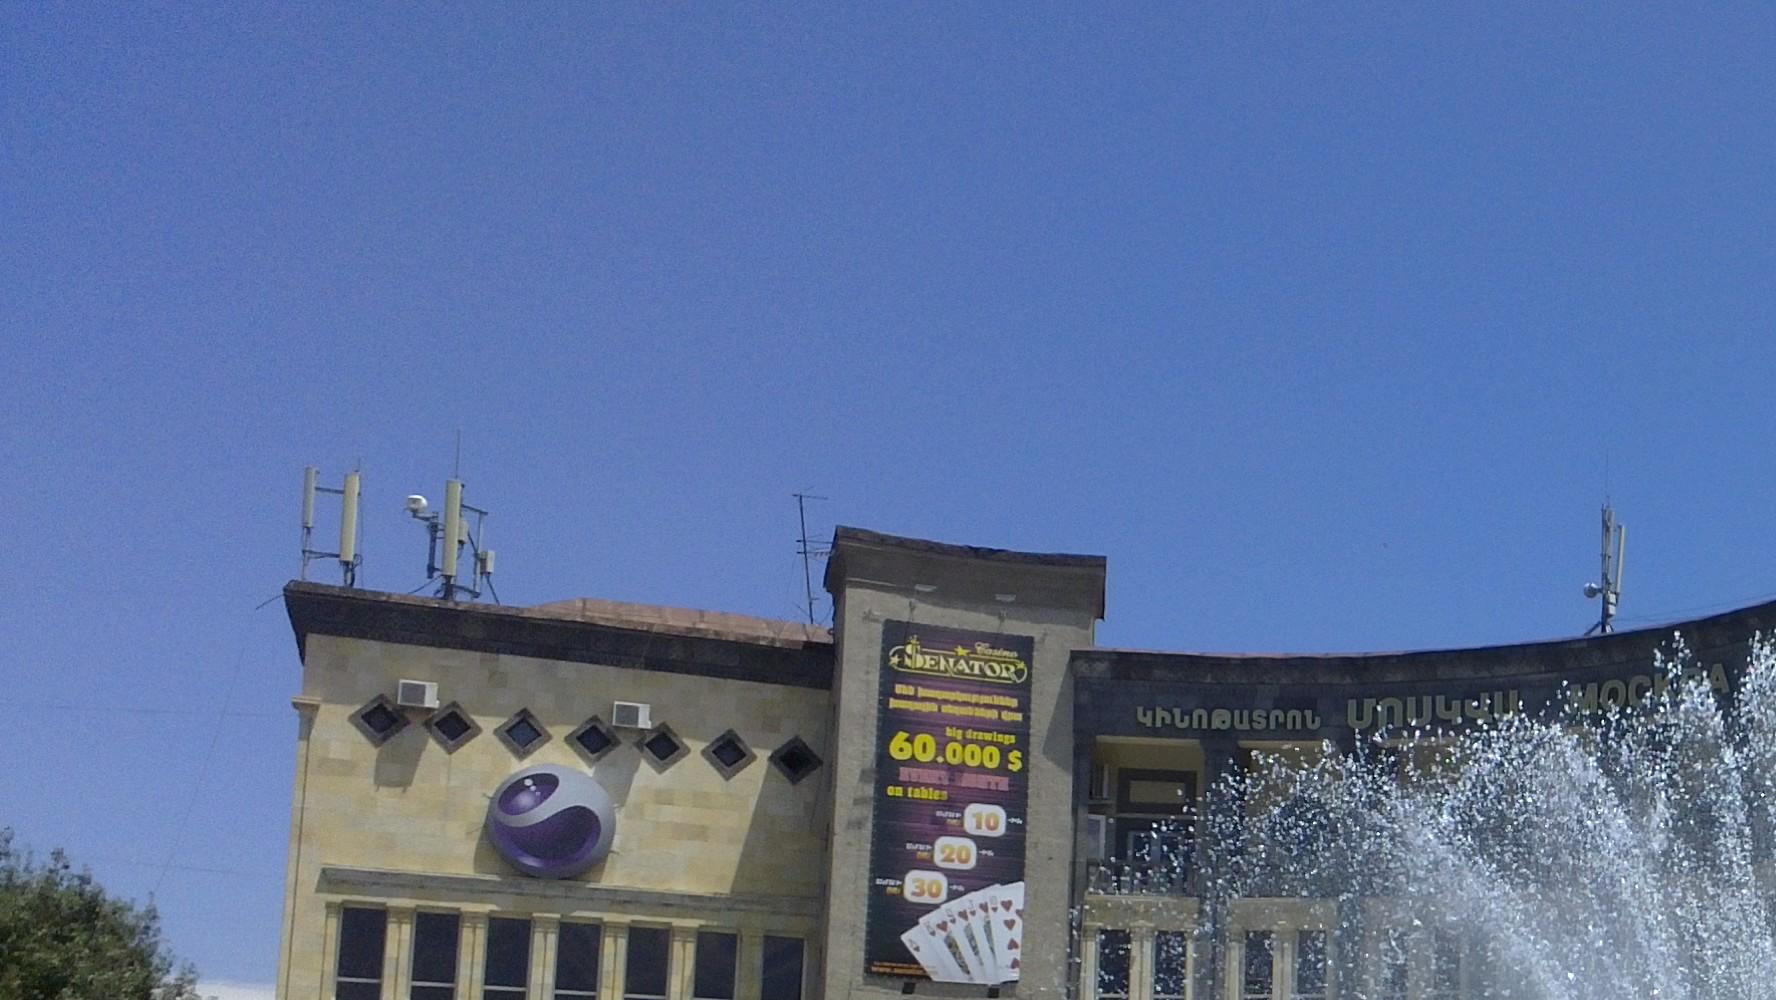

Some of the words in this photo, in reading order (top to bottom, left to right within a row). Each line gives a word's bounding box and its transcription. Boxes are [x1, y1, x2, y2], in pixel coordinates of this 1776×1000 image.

[1136, 705, 1321, 731] ԿԻՆՈԹԱՏՐՈՆ
[1346, 690, 1519, 729] ՄՈՍԿՎԱ
[945, 726, 963, 740] big
[966, 728, 1016, 745] drawings
[889, 731, 1000, 769] 60.000
[1007, 749, 1023, 772] $
[887, 785, 904, 797] on
[907, 786, 948, 801] tables
[972, 811, 1001, 832] 10
[939, 844, 972, 865] 20
[910, 877, 943, 898] 30
